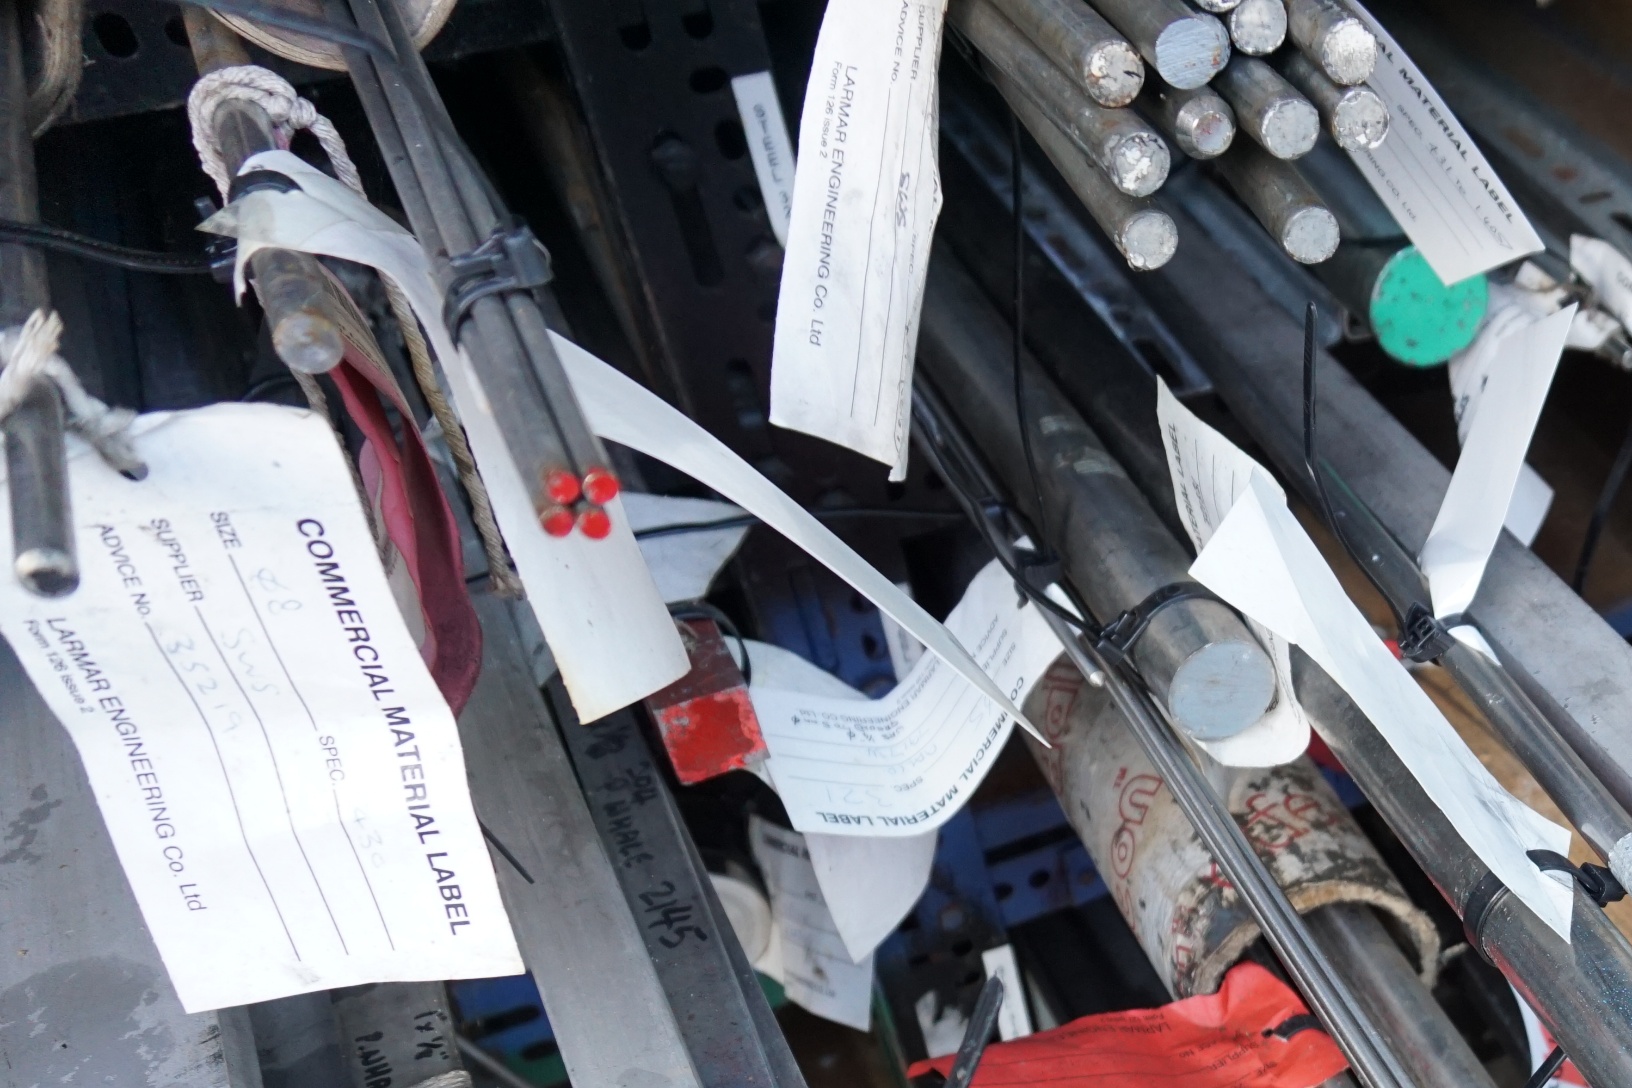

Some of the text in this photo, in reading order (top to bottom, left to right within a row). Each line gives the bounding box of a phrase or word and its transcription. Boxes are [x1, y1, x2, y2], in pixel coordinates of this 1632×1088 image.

[895, 2, 909, 57] ADVICE
[819, 60, 843, 159] Form 126 issue 2
[1399, 67, 1514, 224] MATERIAL LABEL
[808, 65, 858, 347] LARMAR ENGINEERING Co. Ltd
[1167, 422, 1185, 479] LABEL
[99, 524, 151, 620] ADVICE No.
[150, 517, 205, 603] SUPPLIER
[209, 510, 242, 550] SIZE
[23, 618, 95, 716] Form 126 issue 2
[980, 628, 1009, 673] SUPPLIE
[46, 616, 208, 912] LARMAR ENGINEERING Co. Ltd
[296, 517, 471, 936] COMMERCIAL MATERIAL LABEL
[318, 735, 346, 788] SPEC.
[815, 810, 874, 827] LABEL
[877, 783, 960, 827] MATERIAL
